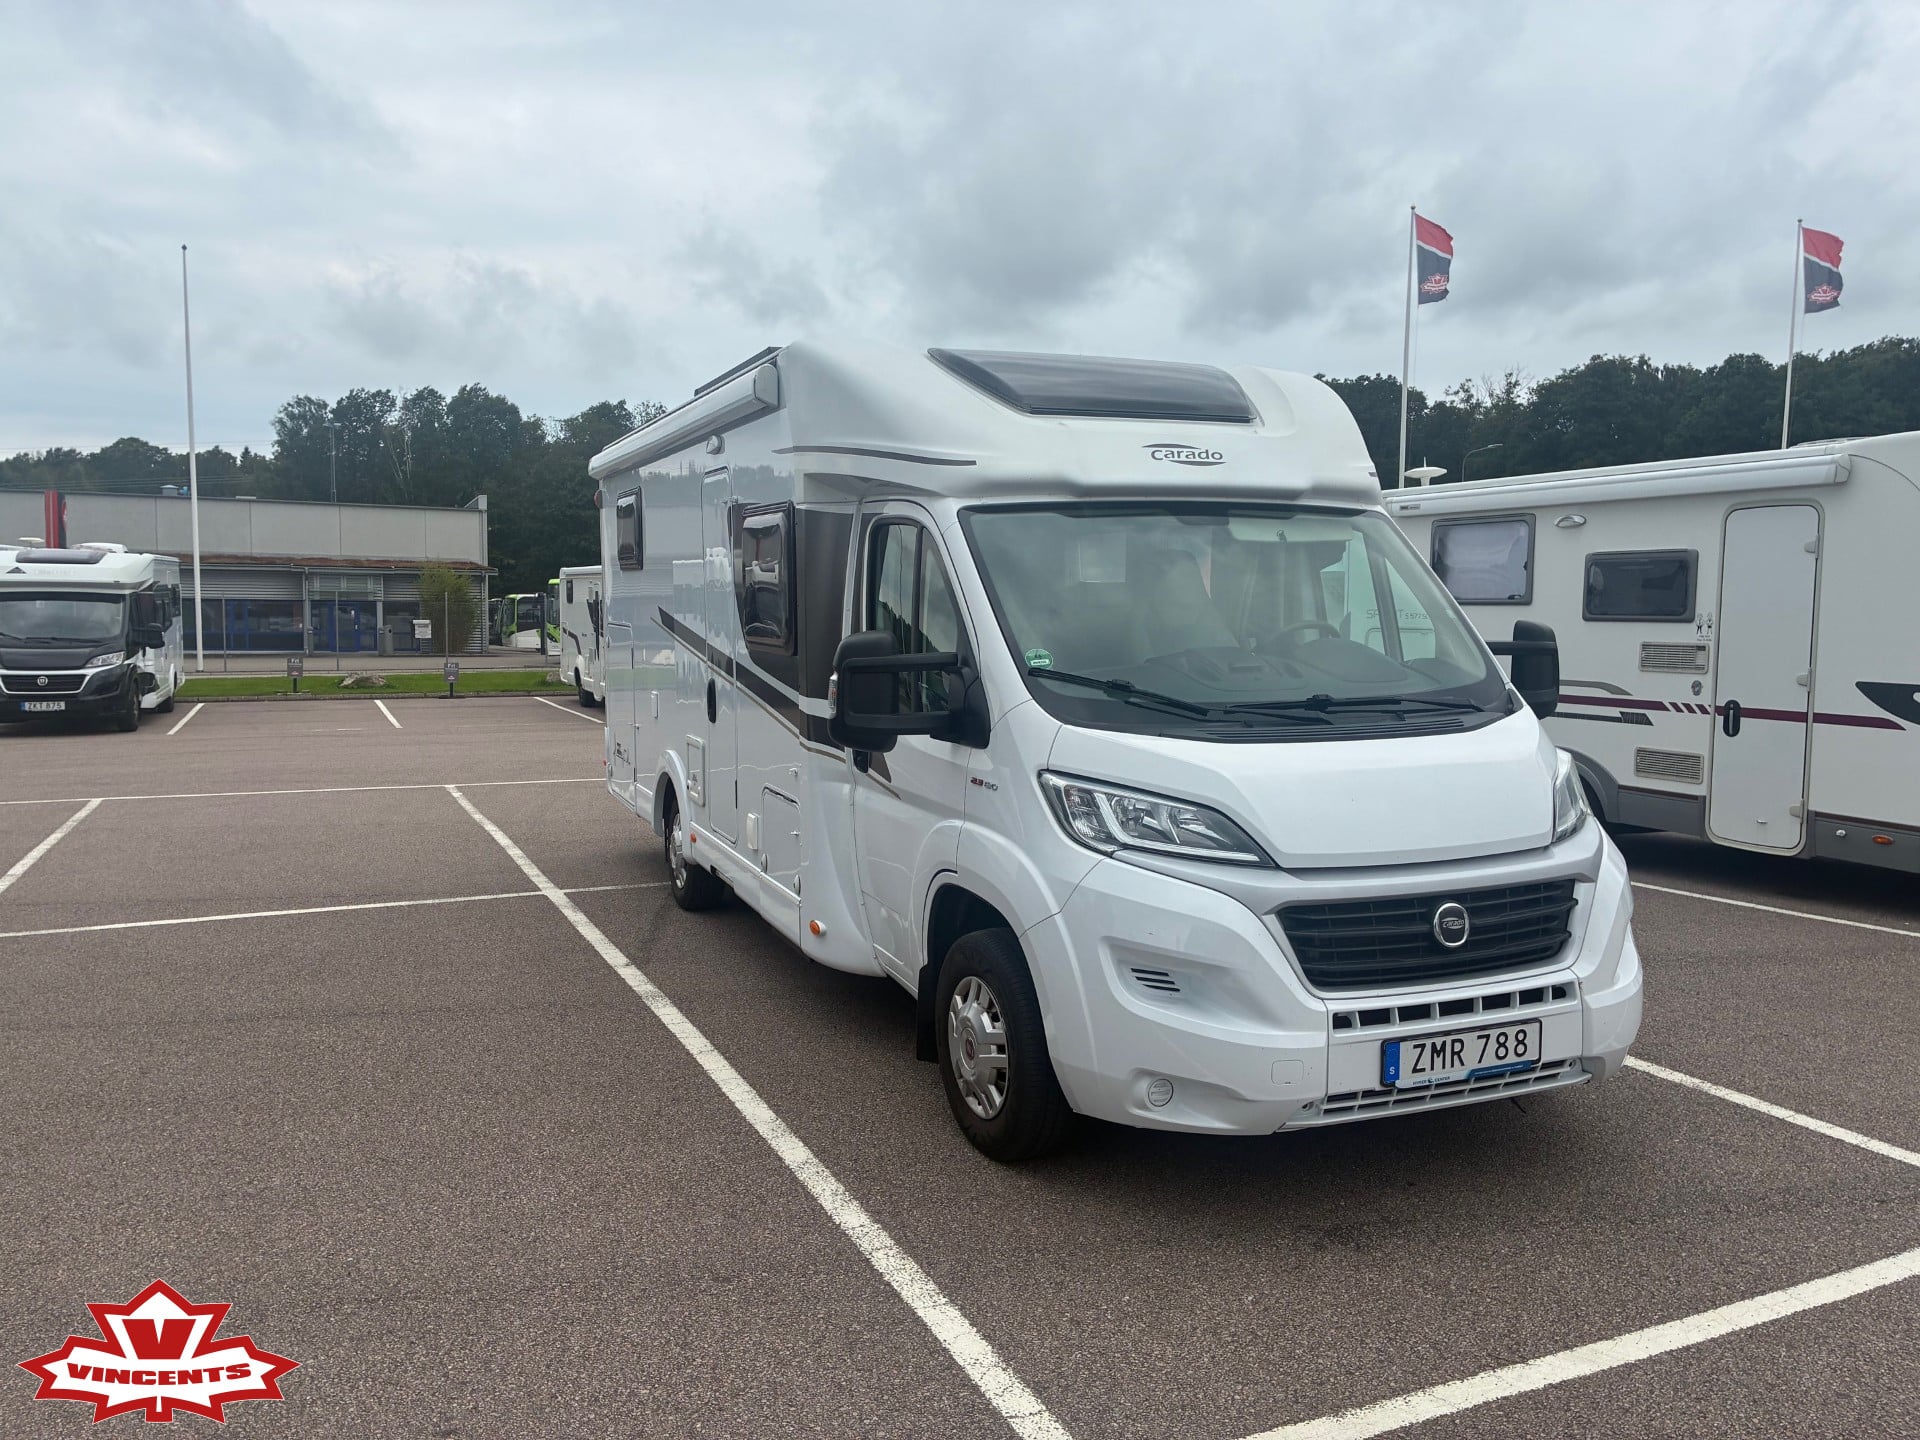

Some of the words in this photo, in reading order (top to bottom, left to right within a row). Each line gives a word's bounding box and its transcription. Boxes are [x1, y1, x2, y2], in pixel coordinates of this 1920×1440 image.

[27, 702, 43, 710] ZKT
[1411, 1038, 1465, 1074] ZMR
[1476, 1028, 1528, 1064] 788
[1388, 1066, 1396, 1075] S
